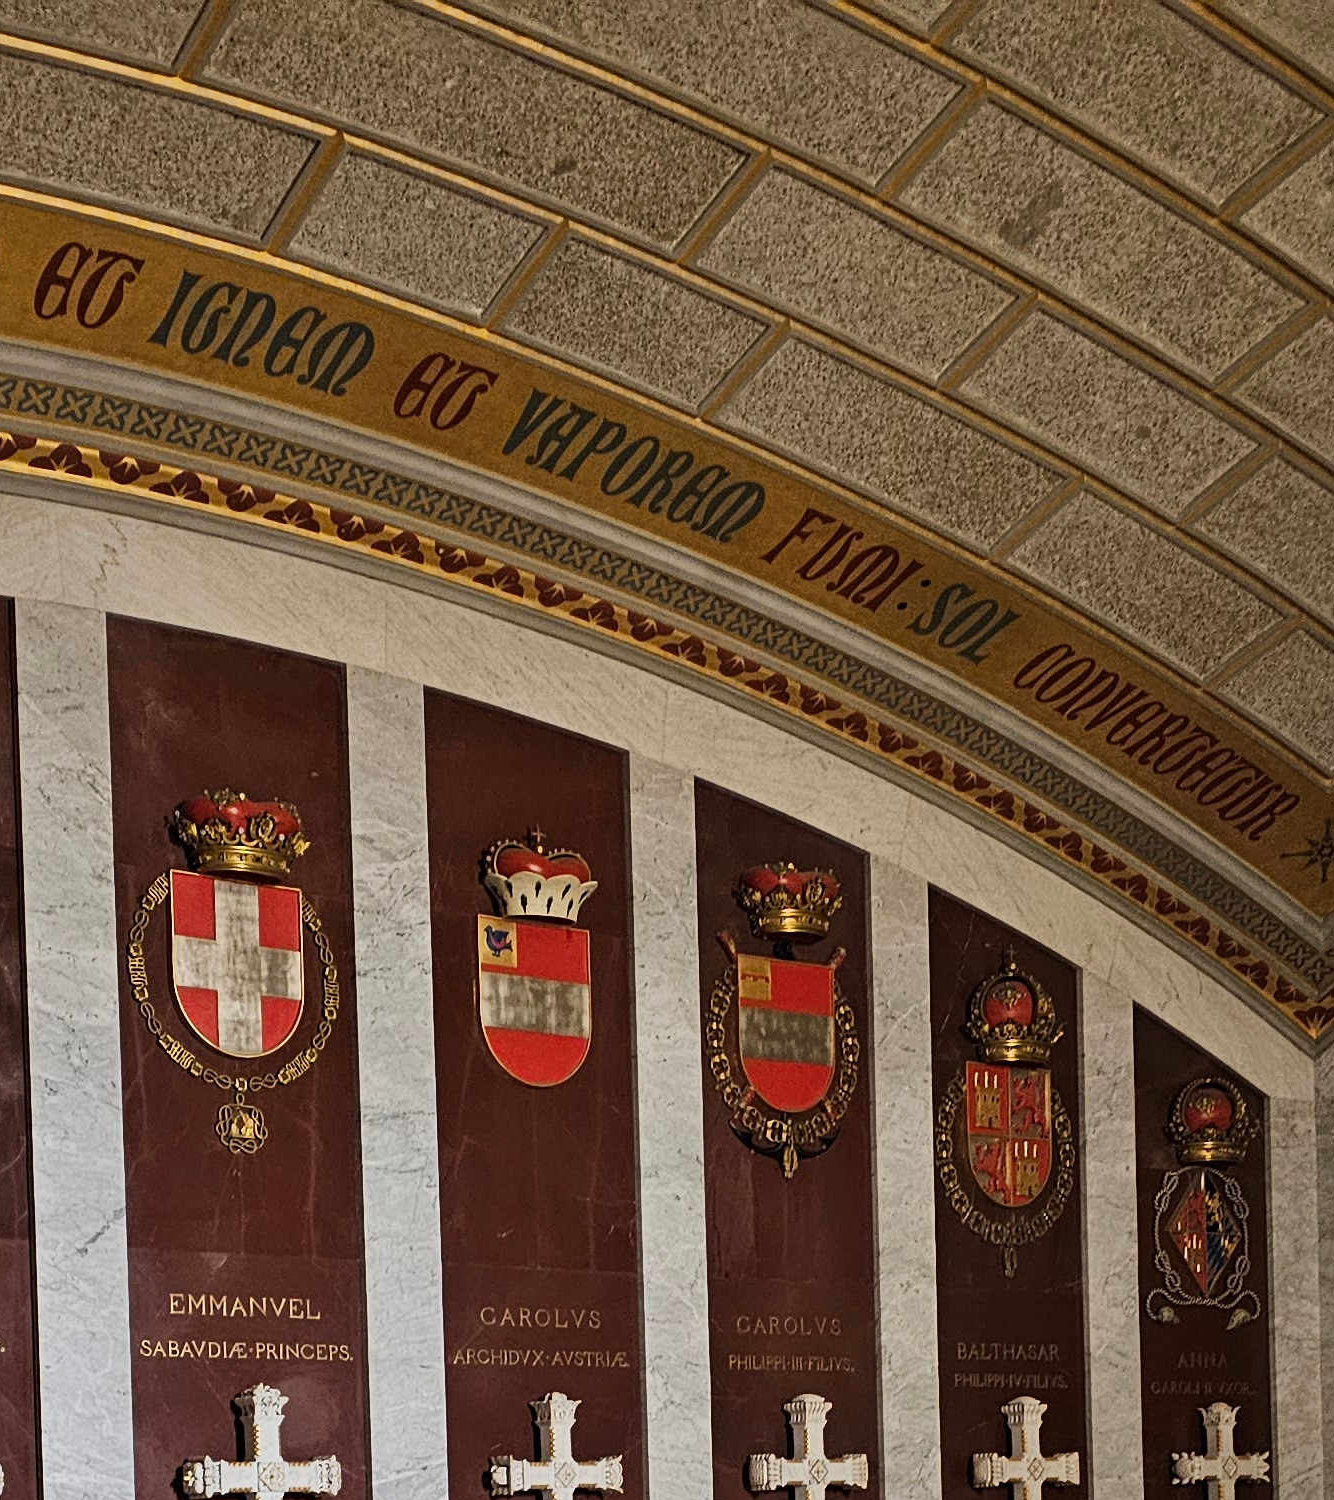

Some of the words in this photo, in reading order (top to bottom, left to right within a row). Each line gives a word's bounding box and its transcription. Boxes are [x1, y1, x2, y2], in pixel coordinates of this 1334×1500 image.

[33, 240, 145, 330] ET
[147, 268, 375, 398] IGNEM
[393, 350, 499, 432] ET
[501, 386, 767, 544] VAPOREM
[906, 581, 1019, 667] SOL
[168, 1293, 322, 1321] EMMANVEL
[479, 1306, 603, 1330] CAROLVS
[736, 1315, 843, 1337] CAROLVS
[956, 1341, 1060, 1361] BALTHASAR
